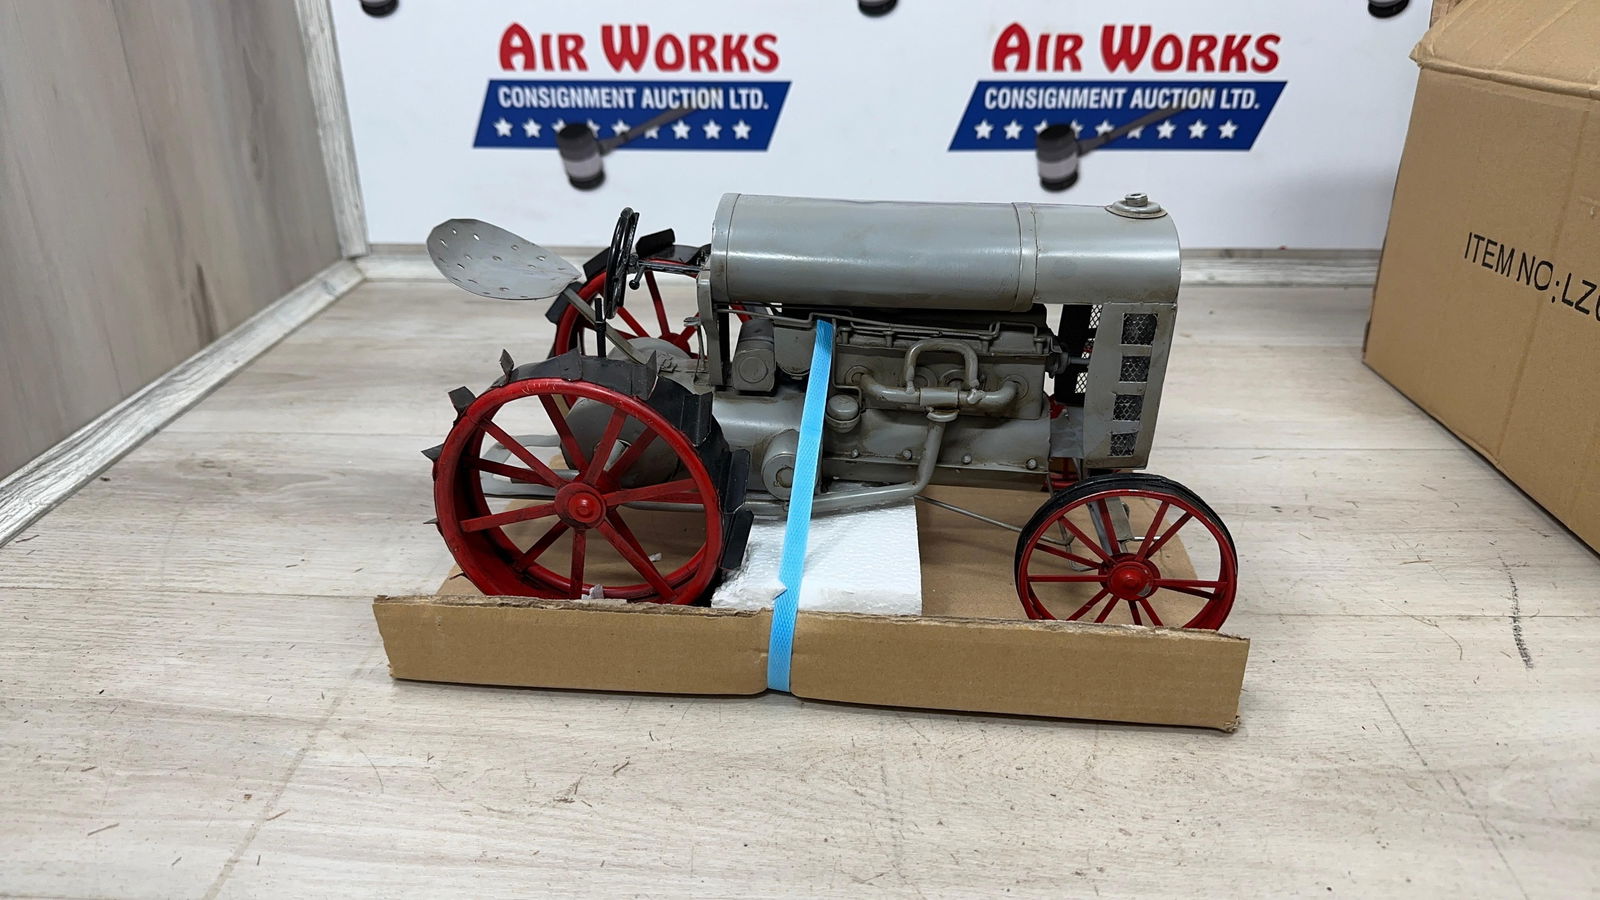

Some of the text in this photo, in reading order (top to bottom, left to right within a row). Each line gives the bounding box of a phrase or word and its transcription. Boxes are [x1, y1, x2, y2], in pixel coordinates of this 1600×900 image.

[498, 22, 780, 73] AIR WORKS
[992, 22, 1281, 73] AIR WORKS
[498, 86, 769, 110] CONSIGNMENT AUCTION LTD.
[984, 87, 1260, 110] CONSIGNMENT AUCTION LTD.
[1464, 231, 1516, 278] ITEM
